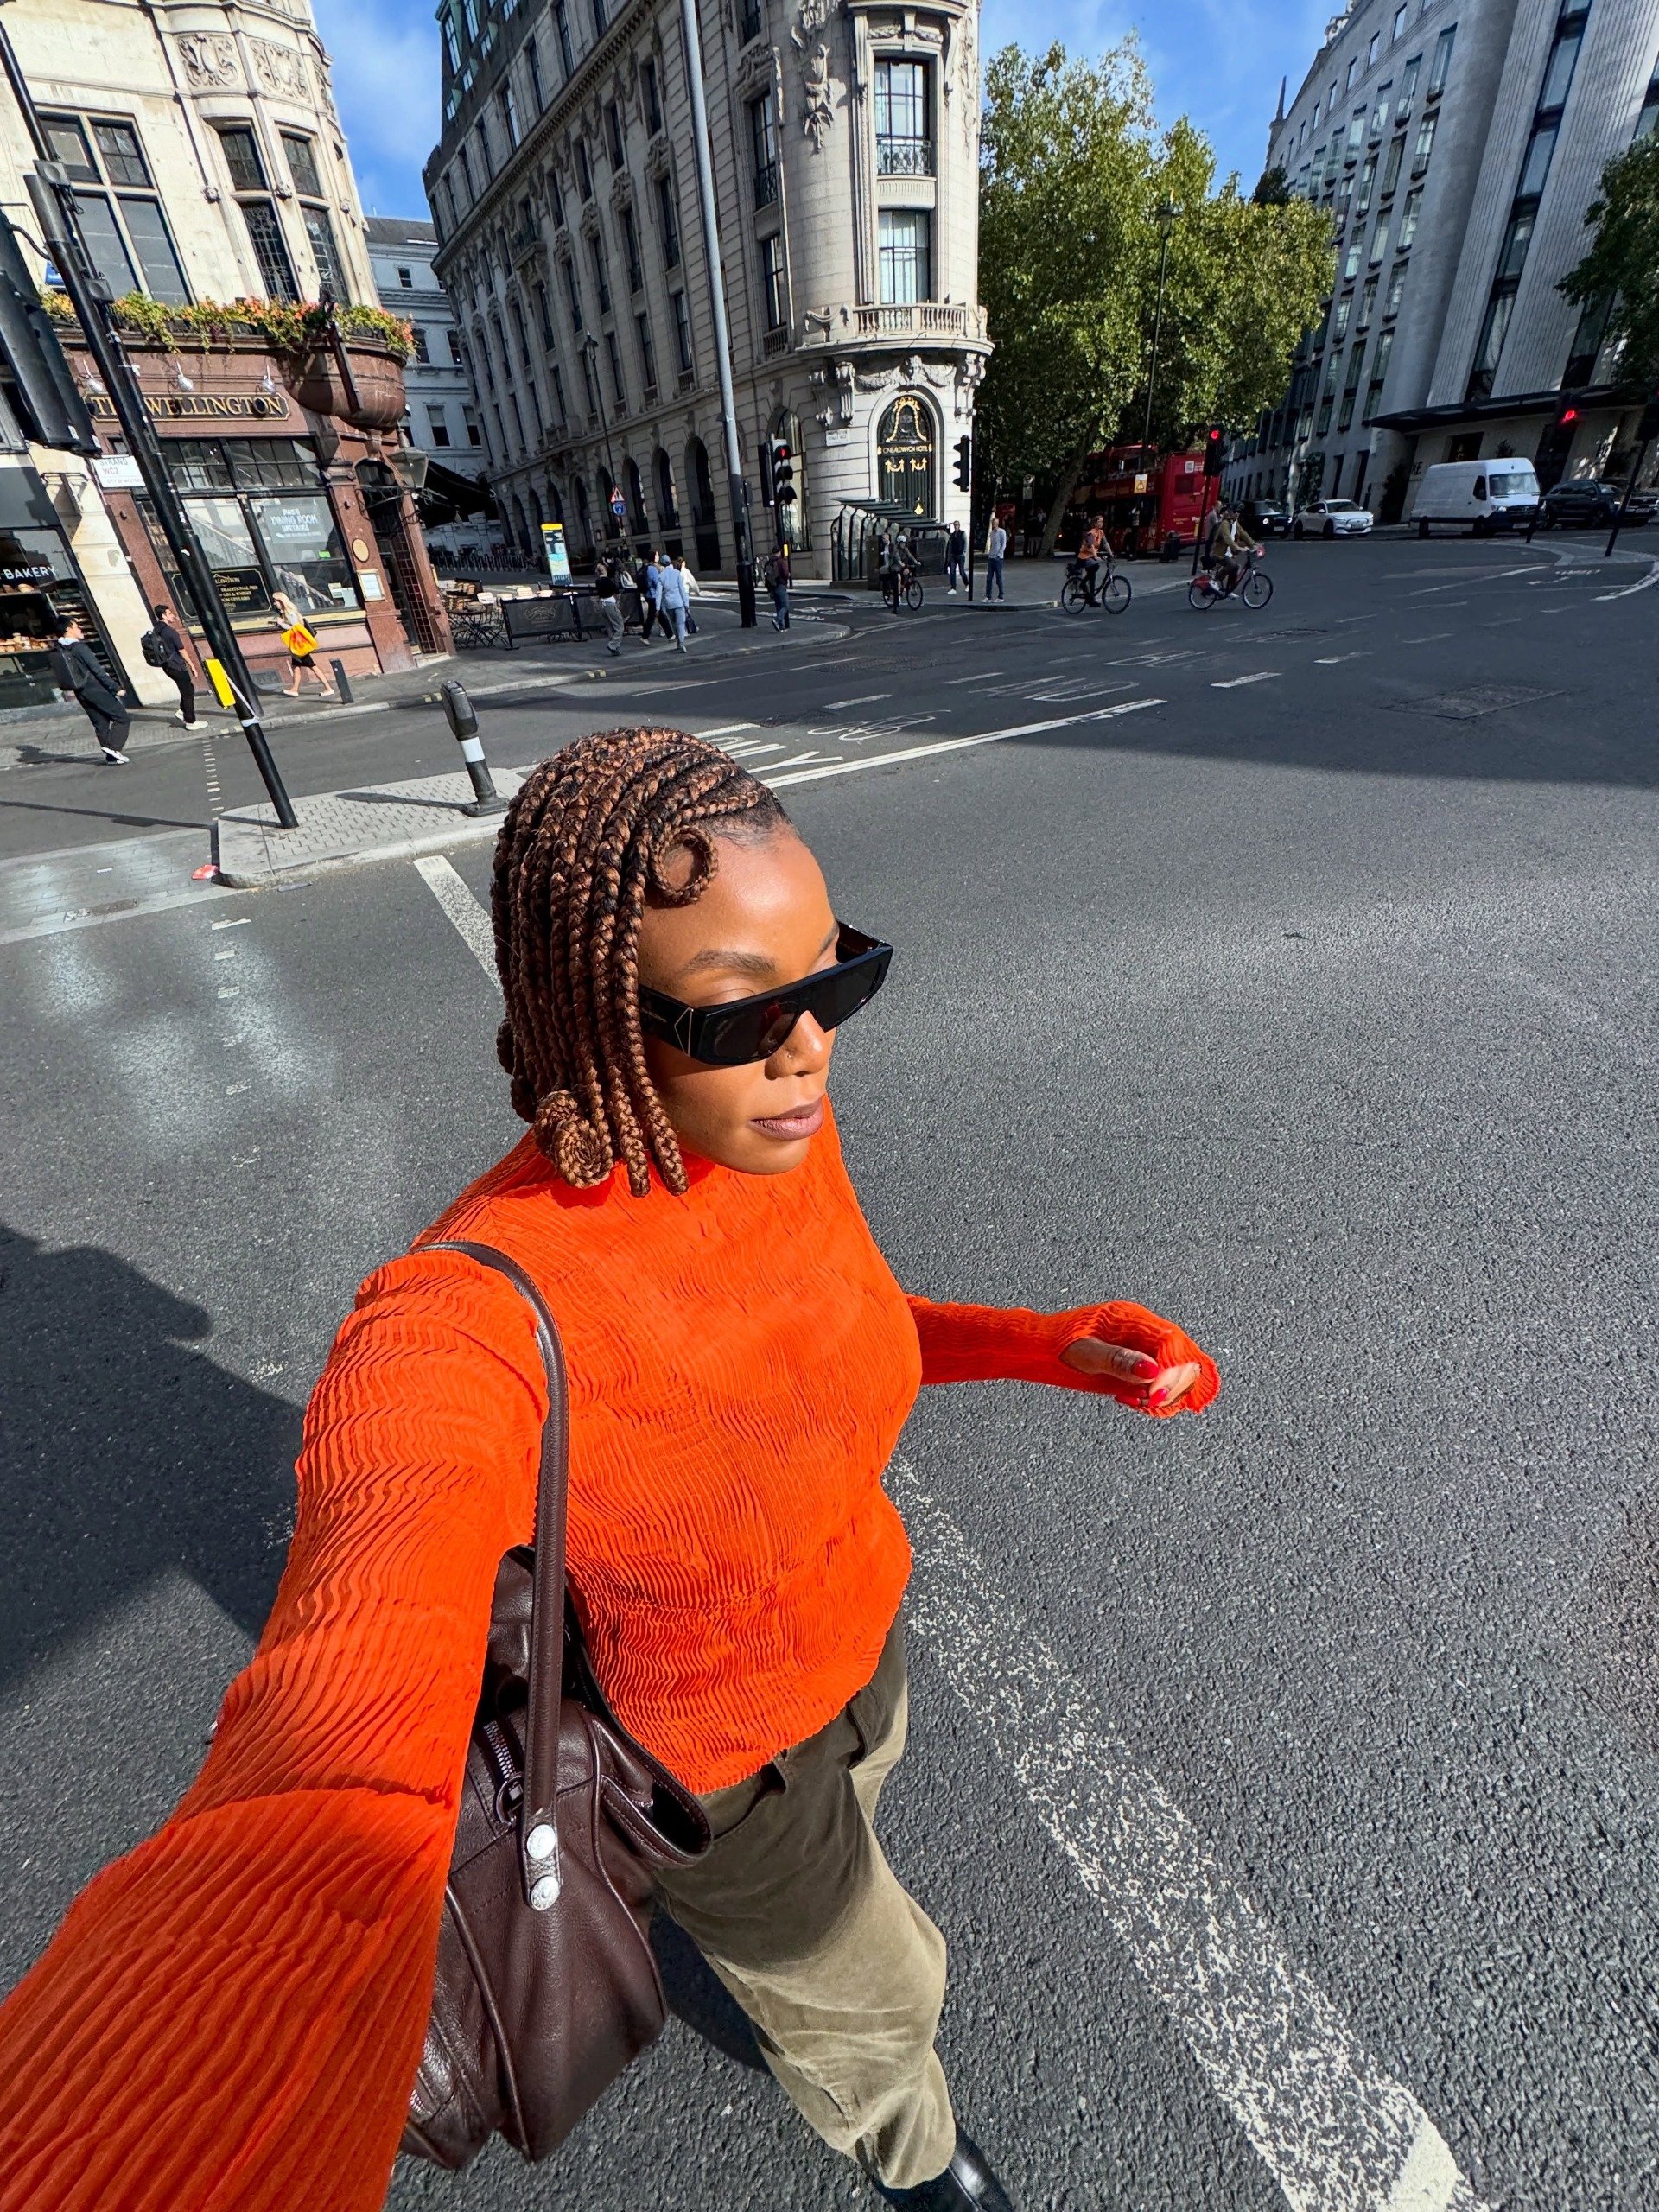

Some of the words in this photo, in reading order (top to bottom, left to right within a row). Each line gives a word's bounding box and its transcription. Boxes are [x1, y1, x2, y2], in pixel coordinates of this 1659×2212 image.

[143, 396, 284, 416] WELLINGTON
[99, 457, 129, 467] STRAND
[270, 515, 297, 526] DINING
[296, 513, 318, 524] ROOM
[281, 524, 310, 532] UPSTAIRS
[3, 565, 56, 580] BAKERY
